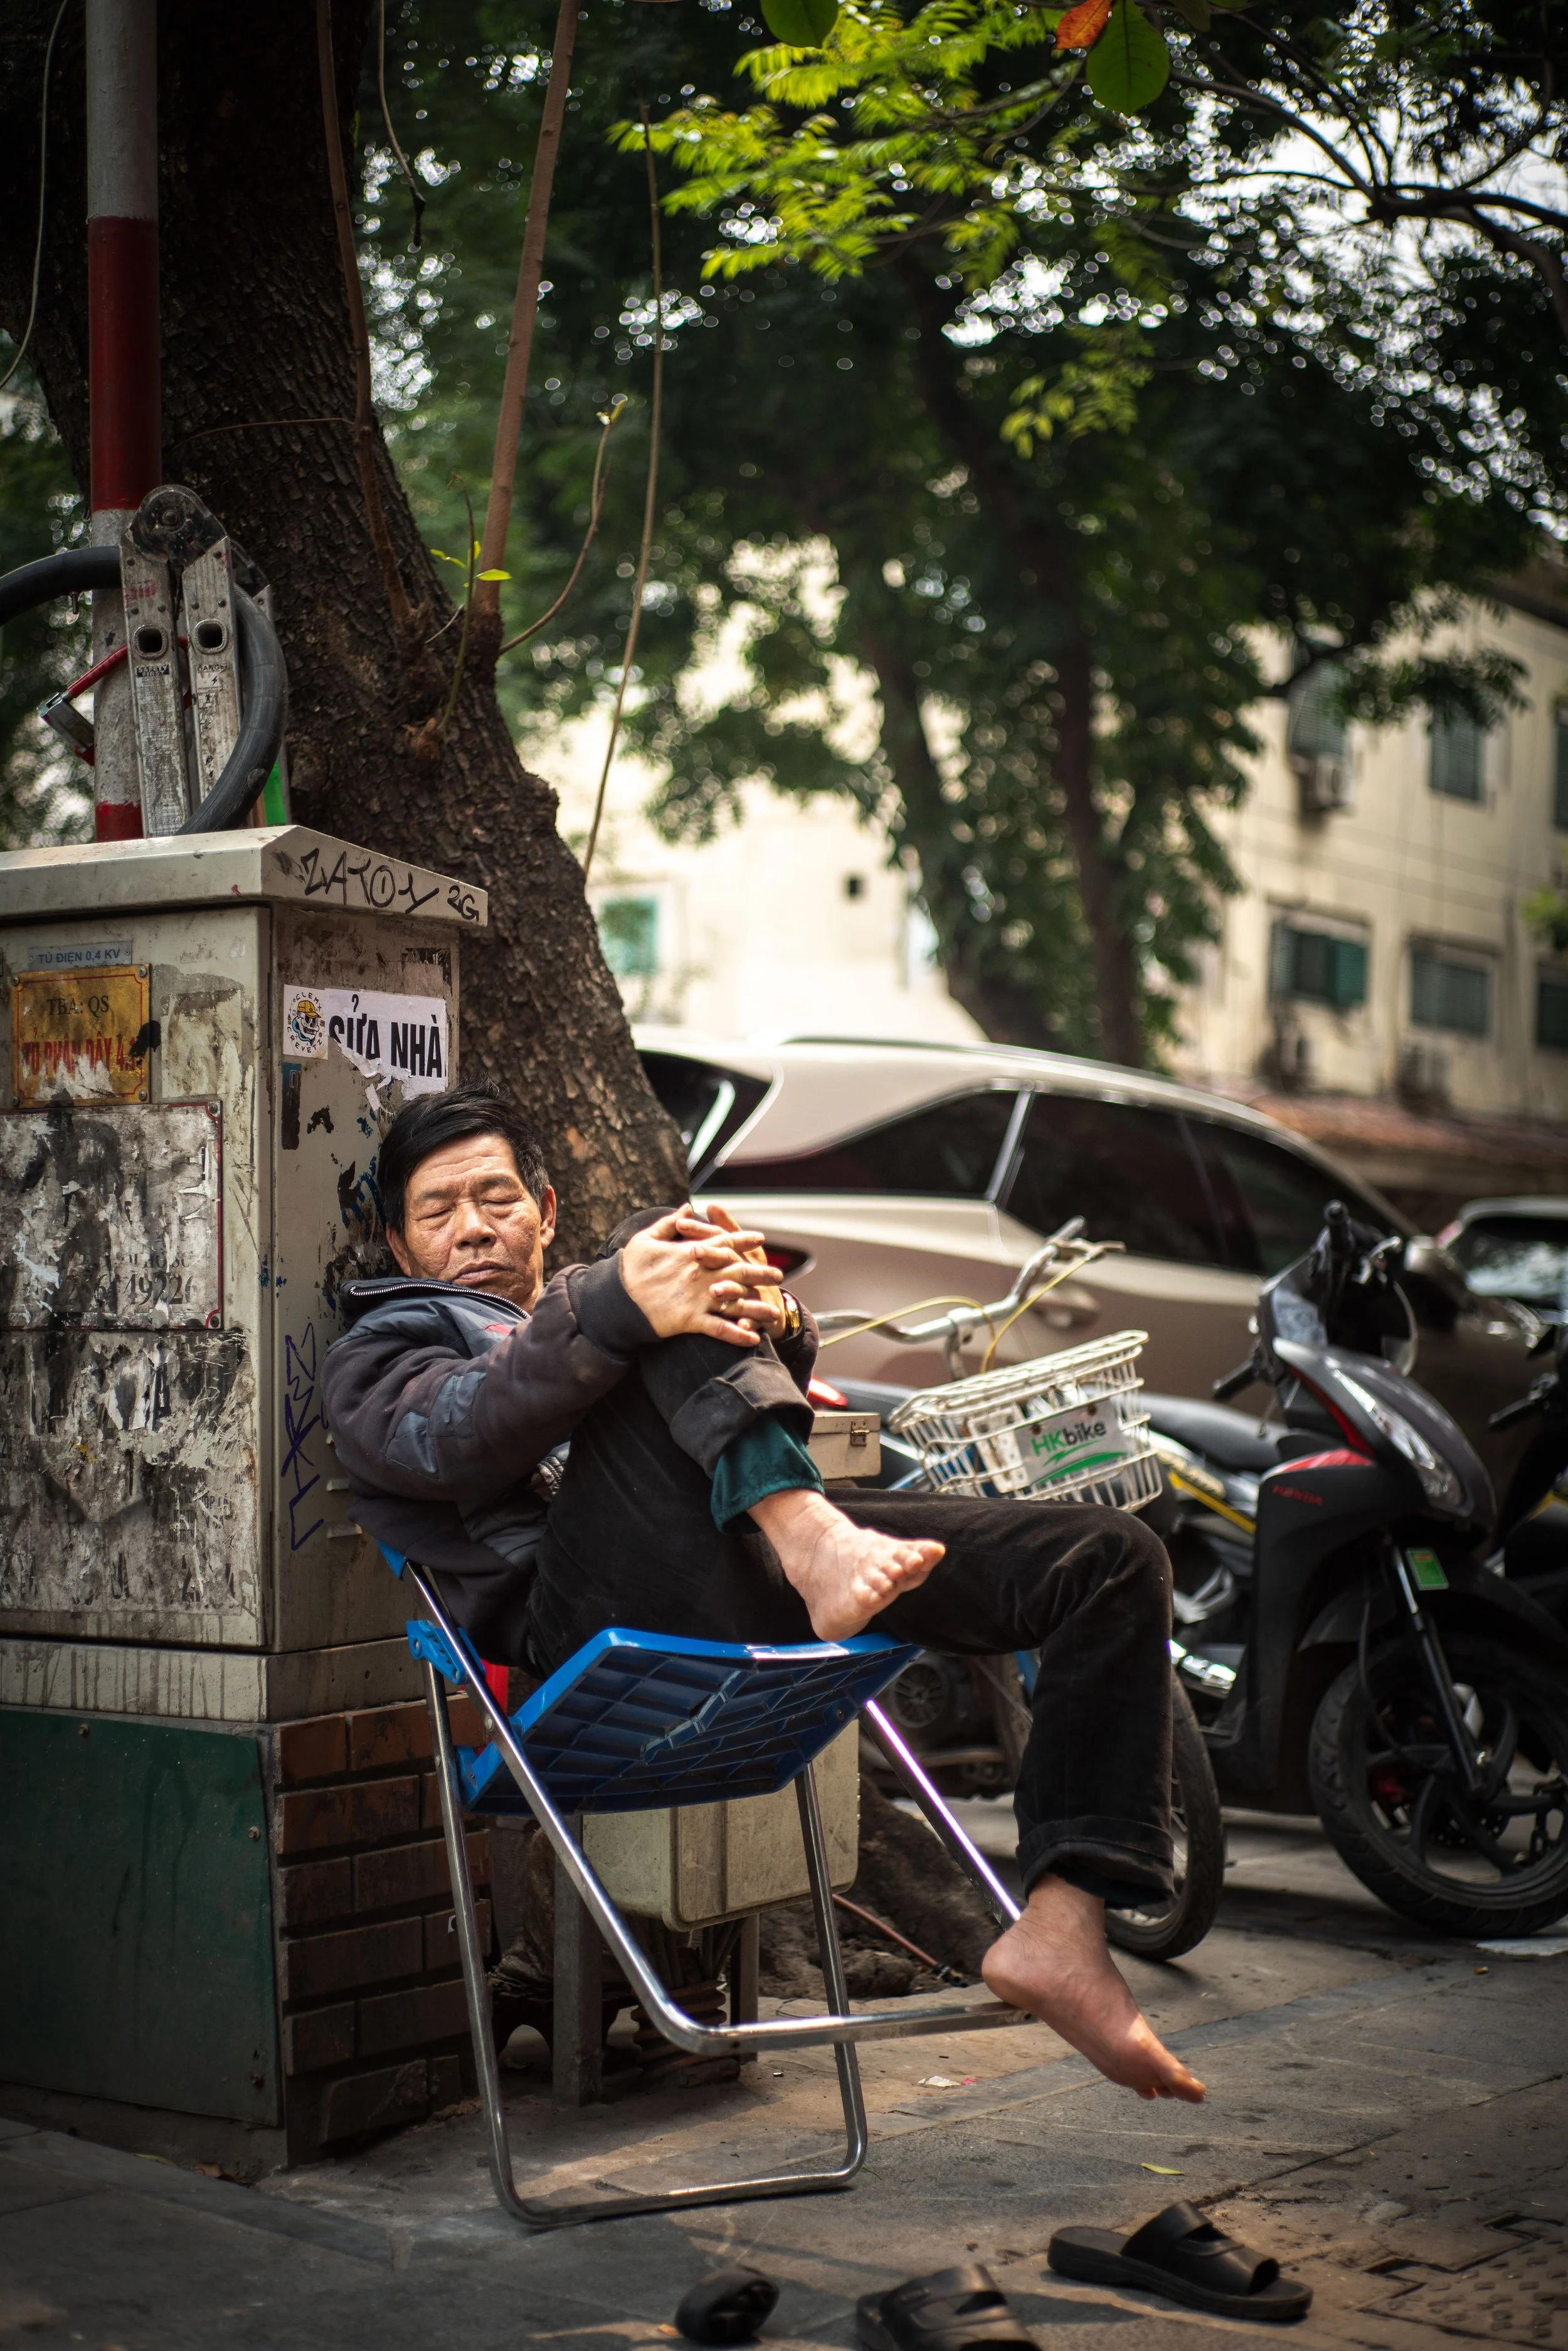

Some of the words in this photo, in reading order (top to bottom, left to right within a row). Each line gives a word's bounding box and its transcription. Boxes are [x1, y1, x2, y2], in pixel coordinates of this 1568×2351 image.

[38, 951, 53, 964] TỦ
[56, 951, 83, 965] ĐIỆN
[85, 949, 102, 962] 0,4
[105, 948, 120, 959] KV
[88, 995, 110, 1017] QS
[328, 994, 381, 1060] SỬA
[390, 1014, 442, 1078] NHÀ
[1030, 1421, 1107, 1457] HKbike
